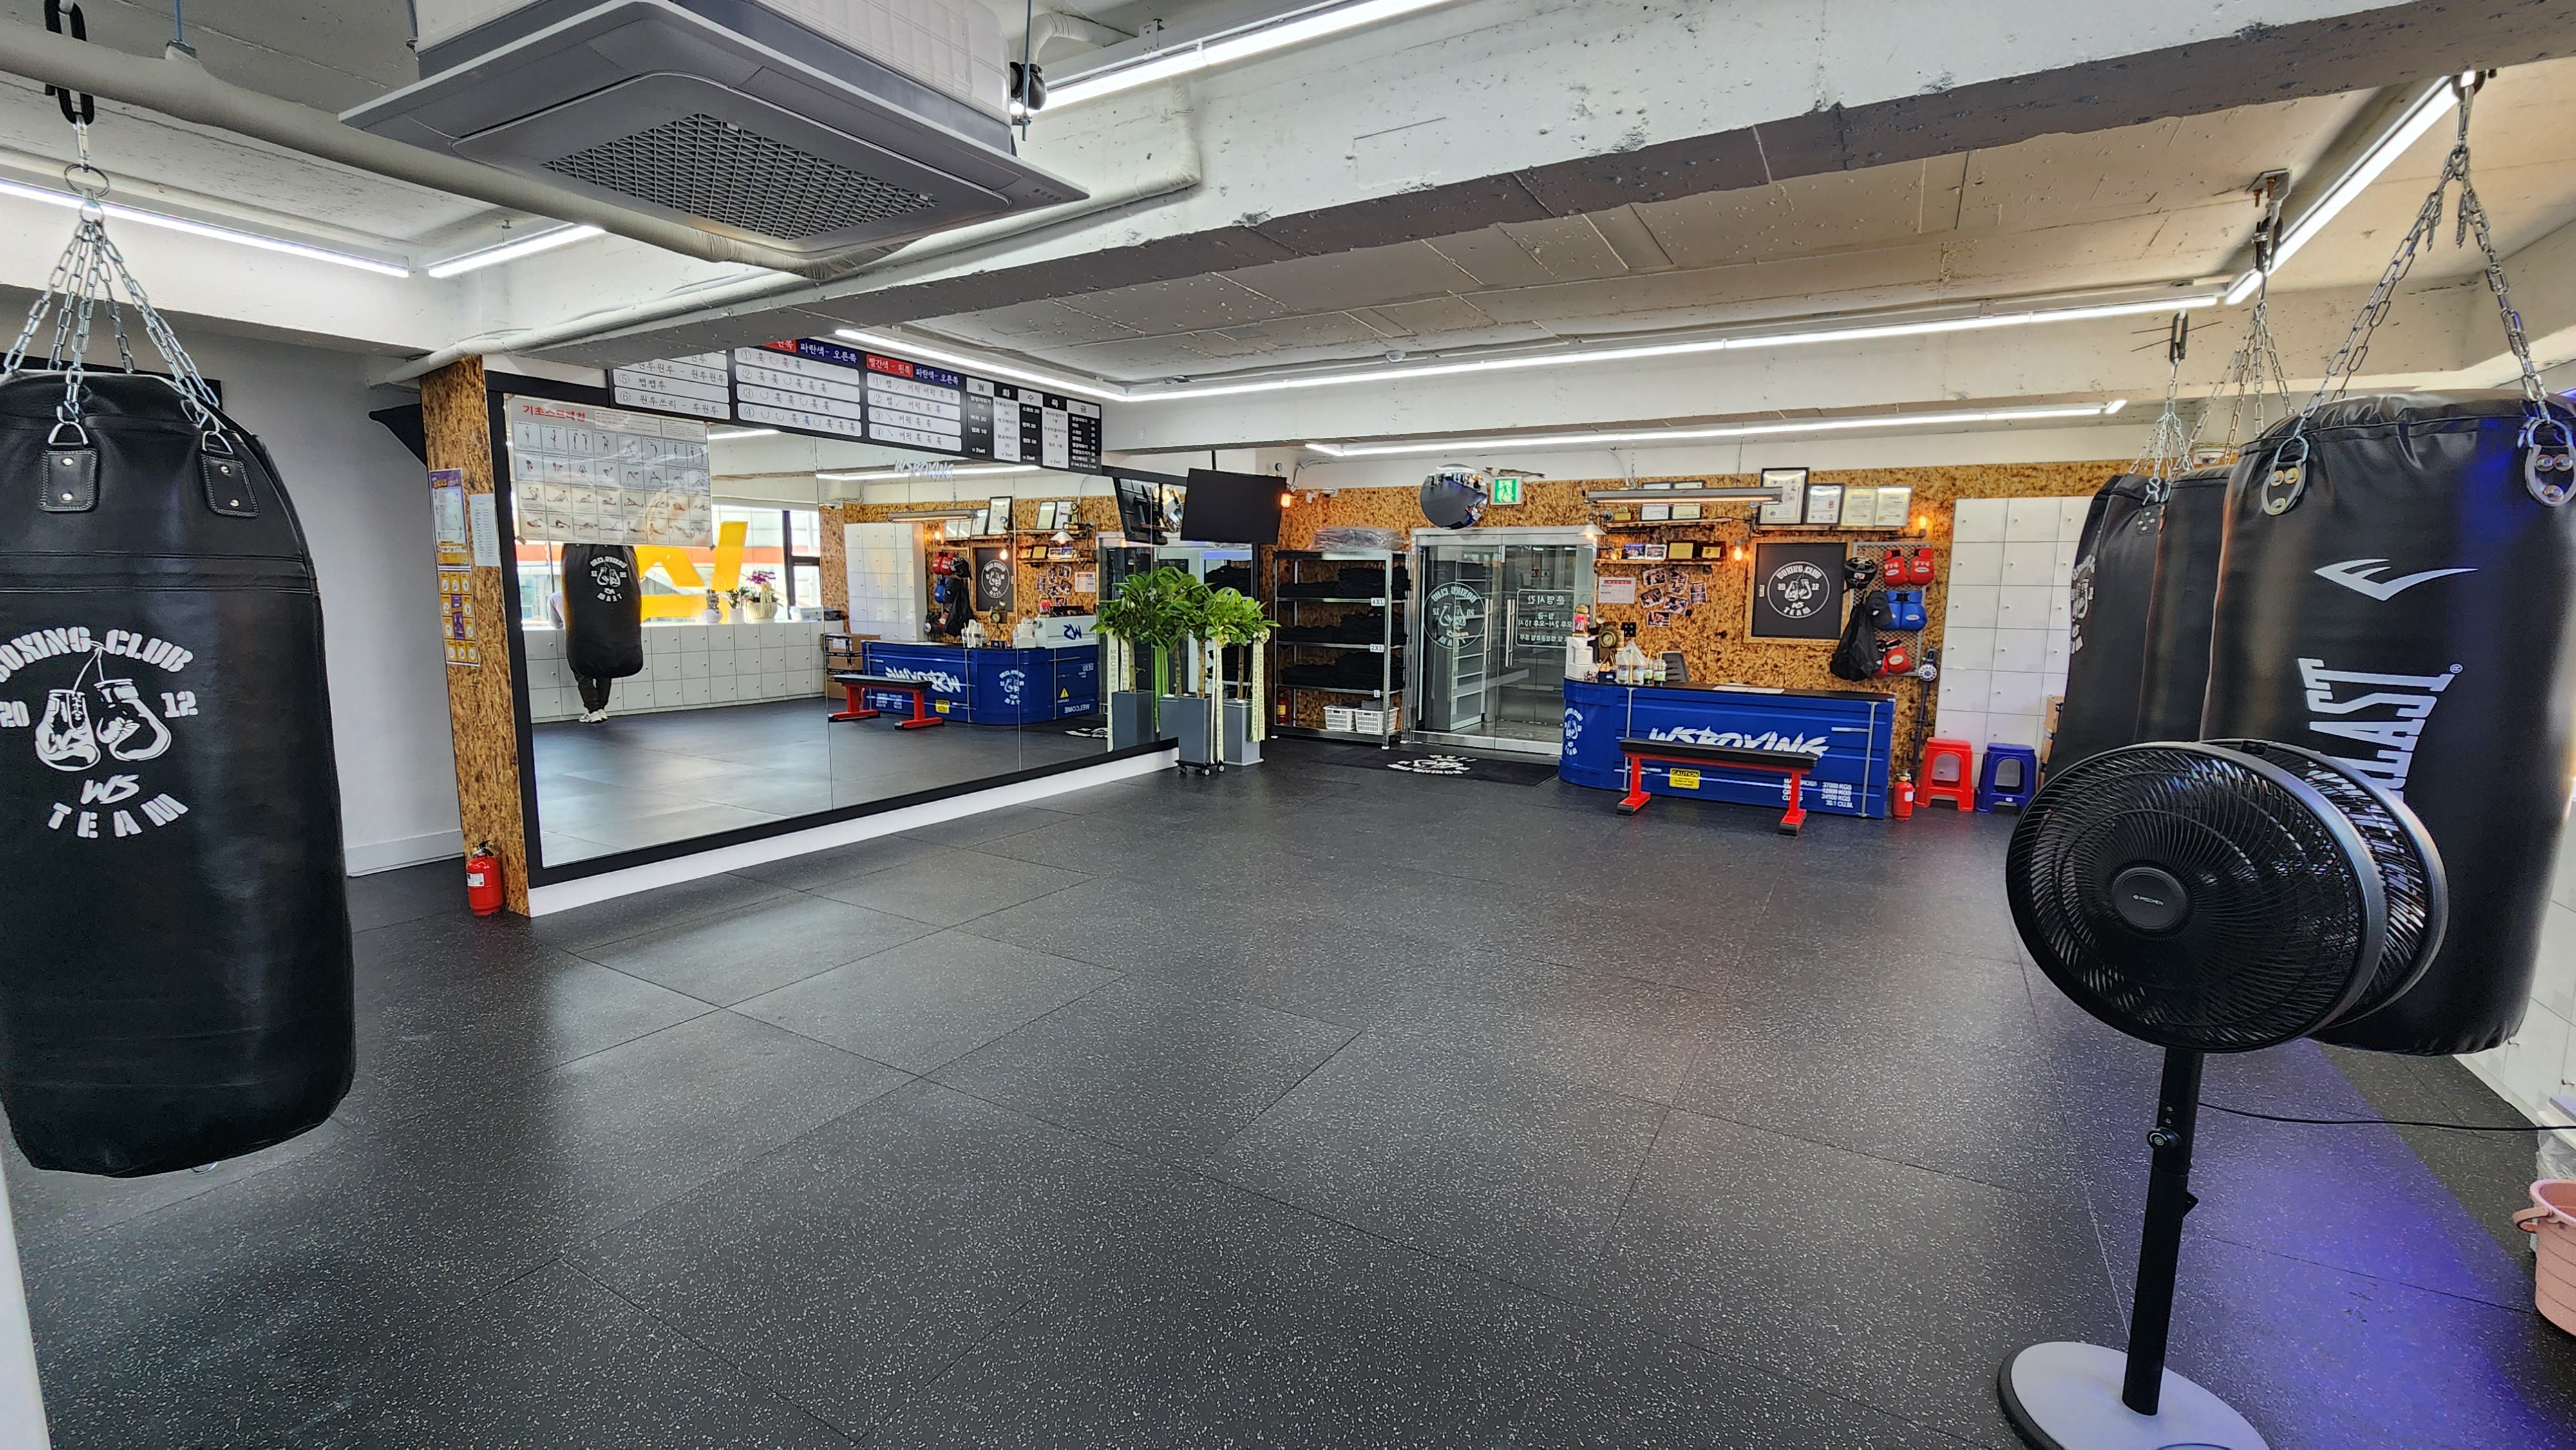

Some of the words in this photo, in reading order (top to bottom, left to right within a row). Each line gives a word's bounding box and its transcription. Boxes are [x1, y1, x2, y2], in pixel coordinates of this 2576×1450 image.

[833, 350, 857, 364] 오른쪽
[977, 384, 984, 392] 월
[1002, 389, 1010, 398] 화
[639, 395, 676, 409] 원투쓰리
[1080, 405, 1086, 413] 금
[1783, 607, 1811, 616] TEAM
[106, 629, 193, 672] CLUB
[161, 691, 198, 718] 12
[80, 774, 139, 804] WS
[48, 793, 189, 838] TEAM
